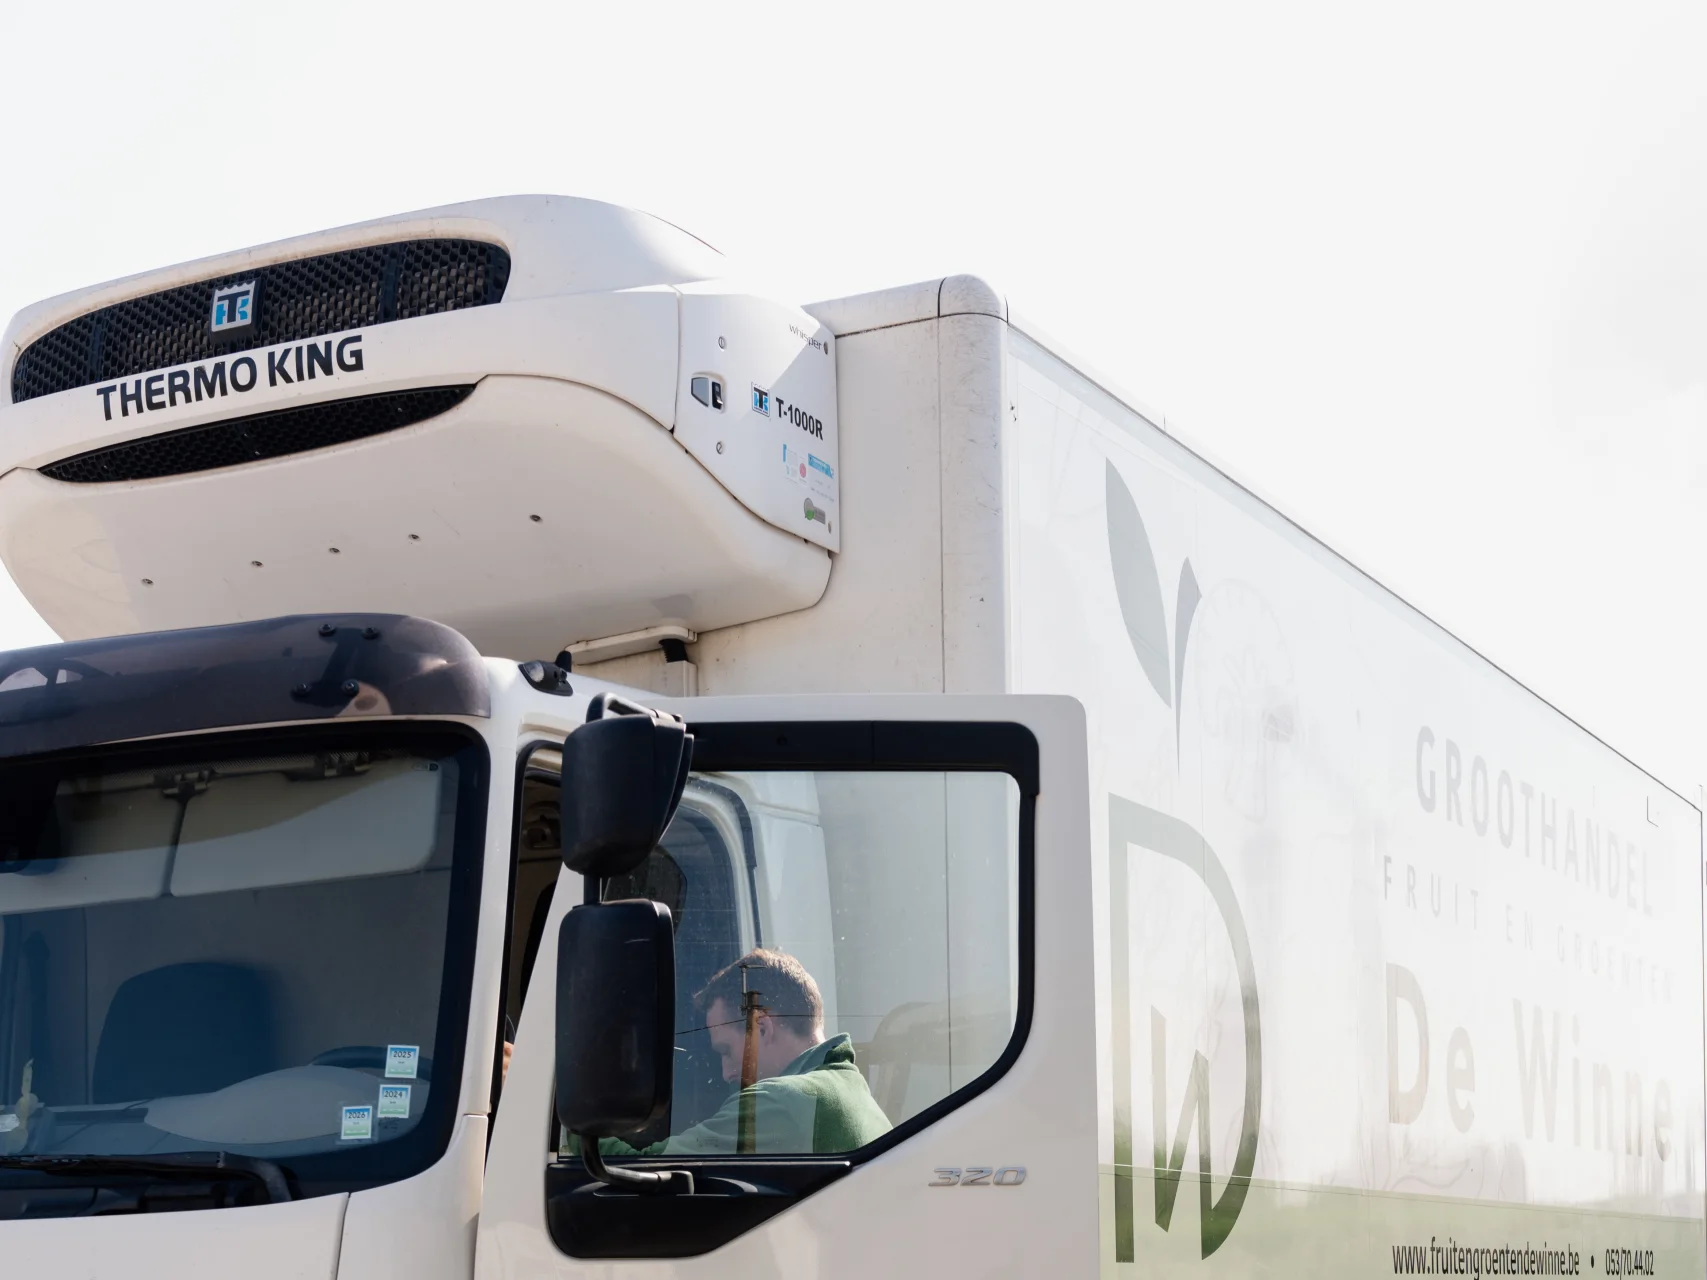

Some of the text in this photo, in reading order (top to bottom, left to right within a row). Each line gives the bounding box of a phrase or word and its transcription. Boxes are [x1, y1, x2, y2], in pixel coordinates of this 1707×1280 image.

[788, 323, 822, 350] whisper
[97, 334, 364, 421] THERMO KING
[776, 397, 823, 441] T-1000R
[1415, 725, 1653, 917] GROOTHANDEL
[1383, 855, 1674, 1005] FRUIT EN GROENTEN
[393, 1050, 412, 1059] 2025
[1386, 962, 1672, 1163] De Winne
[384, 1090, 403, 1098] 2024
[348, 1111, 366, 1119] 2026
[928, 1167, 1026, 1186] 320
[1605, 1246, 1654, 1280] 053/70.44.02
